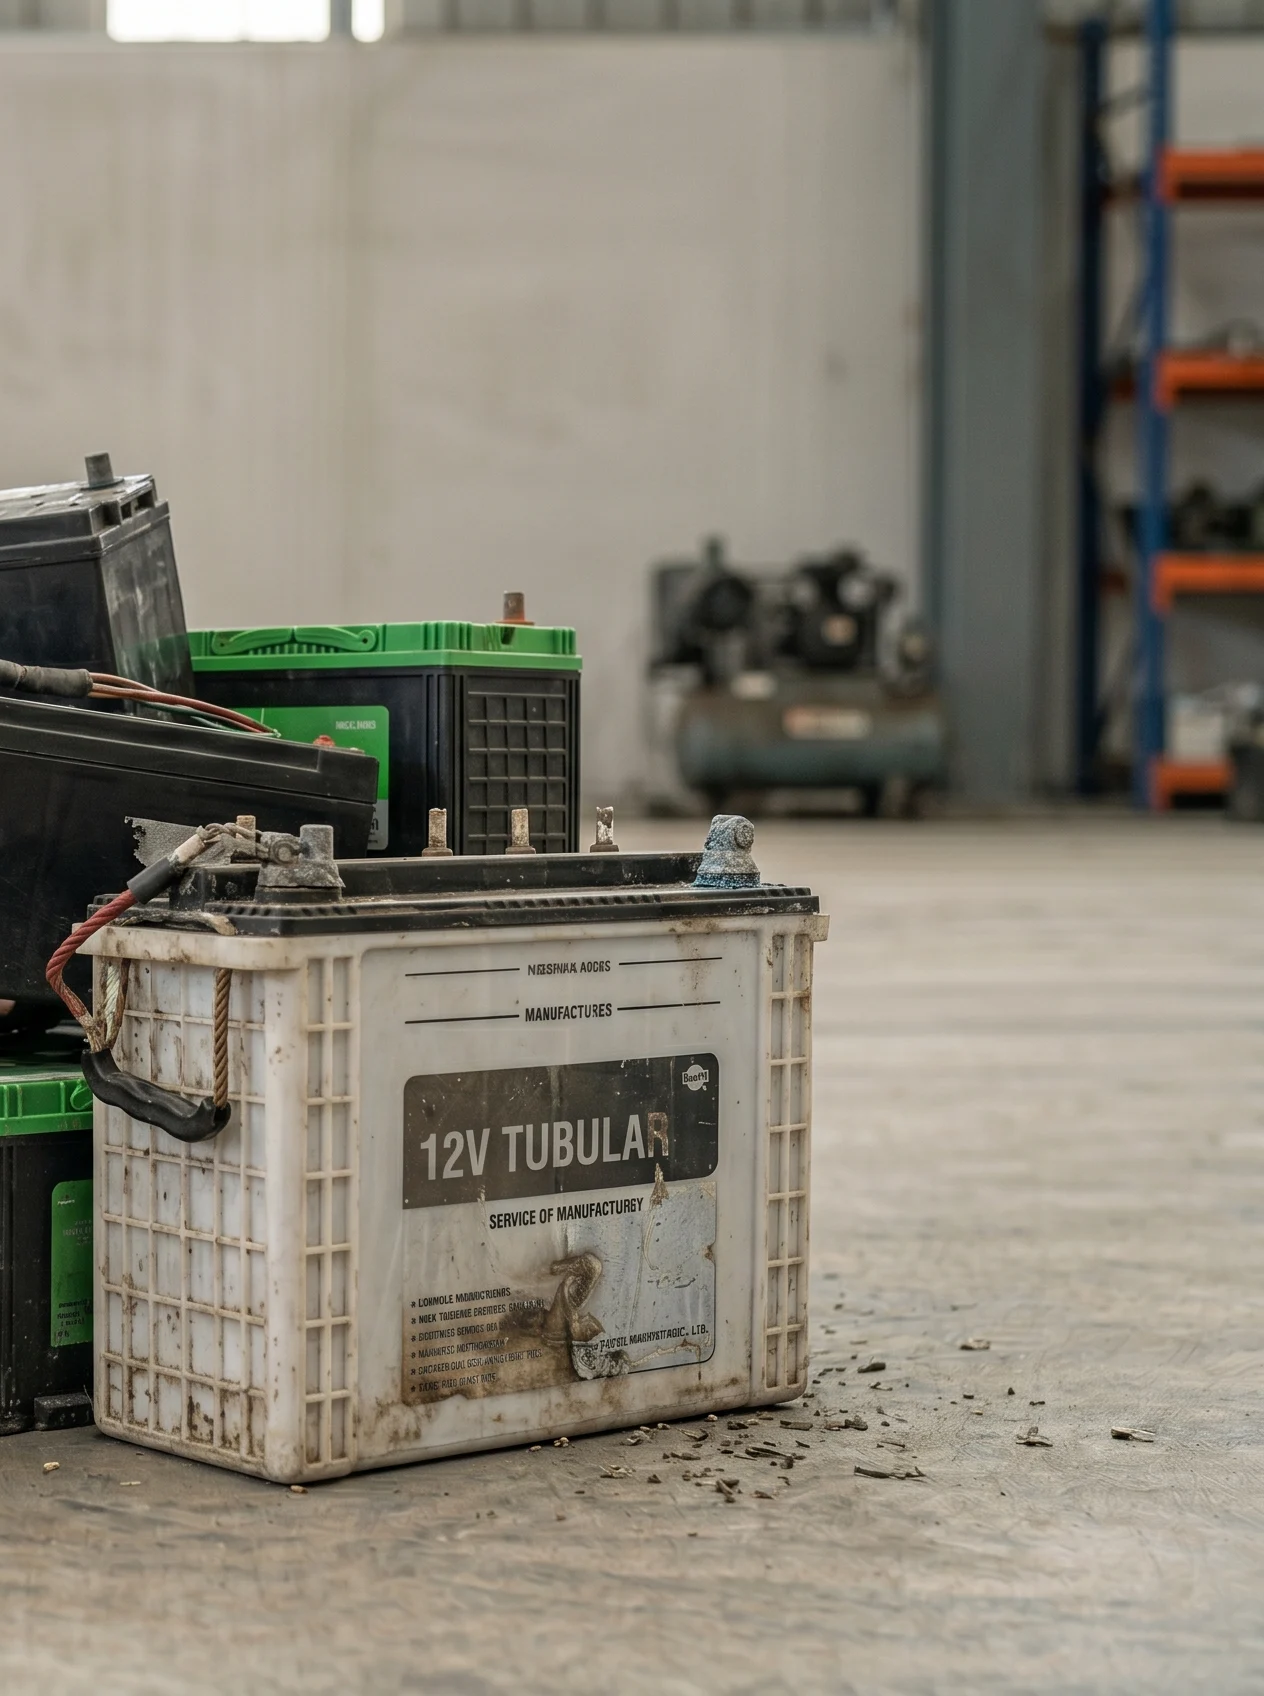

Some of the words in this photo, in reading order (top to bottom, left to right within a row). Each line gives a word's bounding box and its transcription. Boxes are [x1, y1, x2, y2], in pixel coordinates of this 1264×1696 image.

[525, 1003, 612, 1022] MANUFACTURES
[420, 1128, 490, 1181] 12V
[502, 1112, 669, 1173] TUBULAR
[489, 1210, 536, 1229] SERVICE
[539, 1208, 554, 1224] OF
